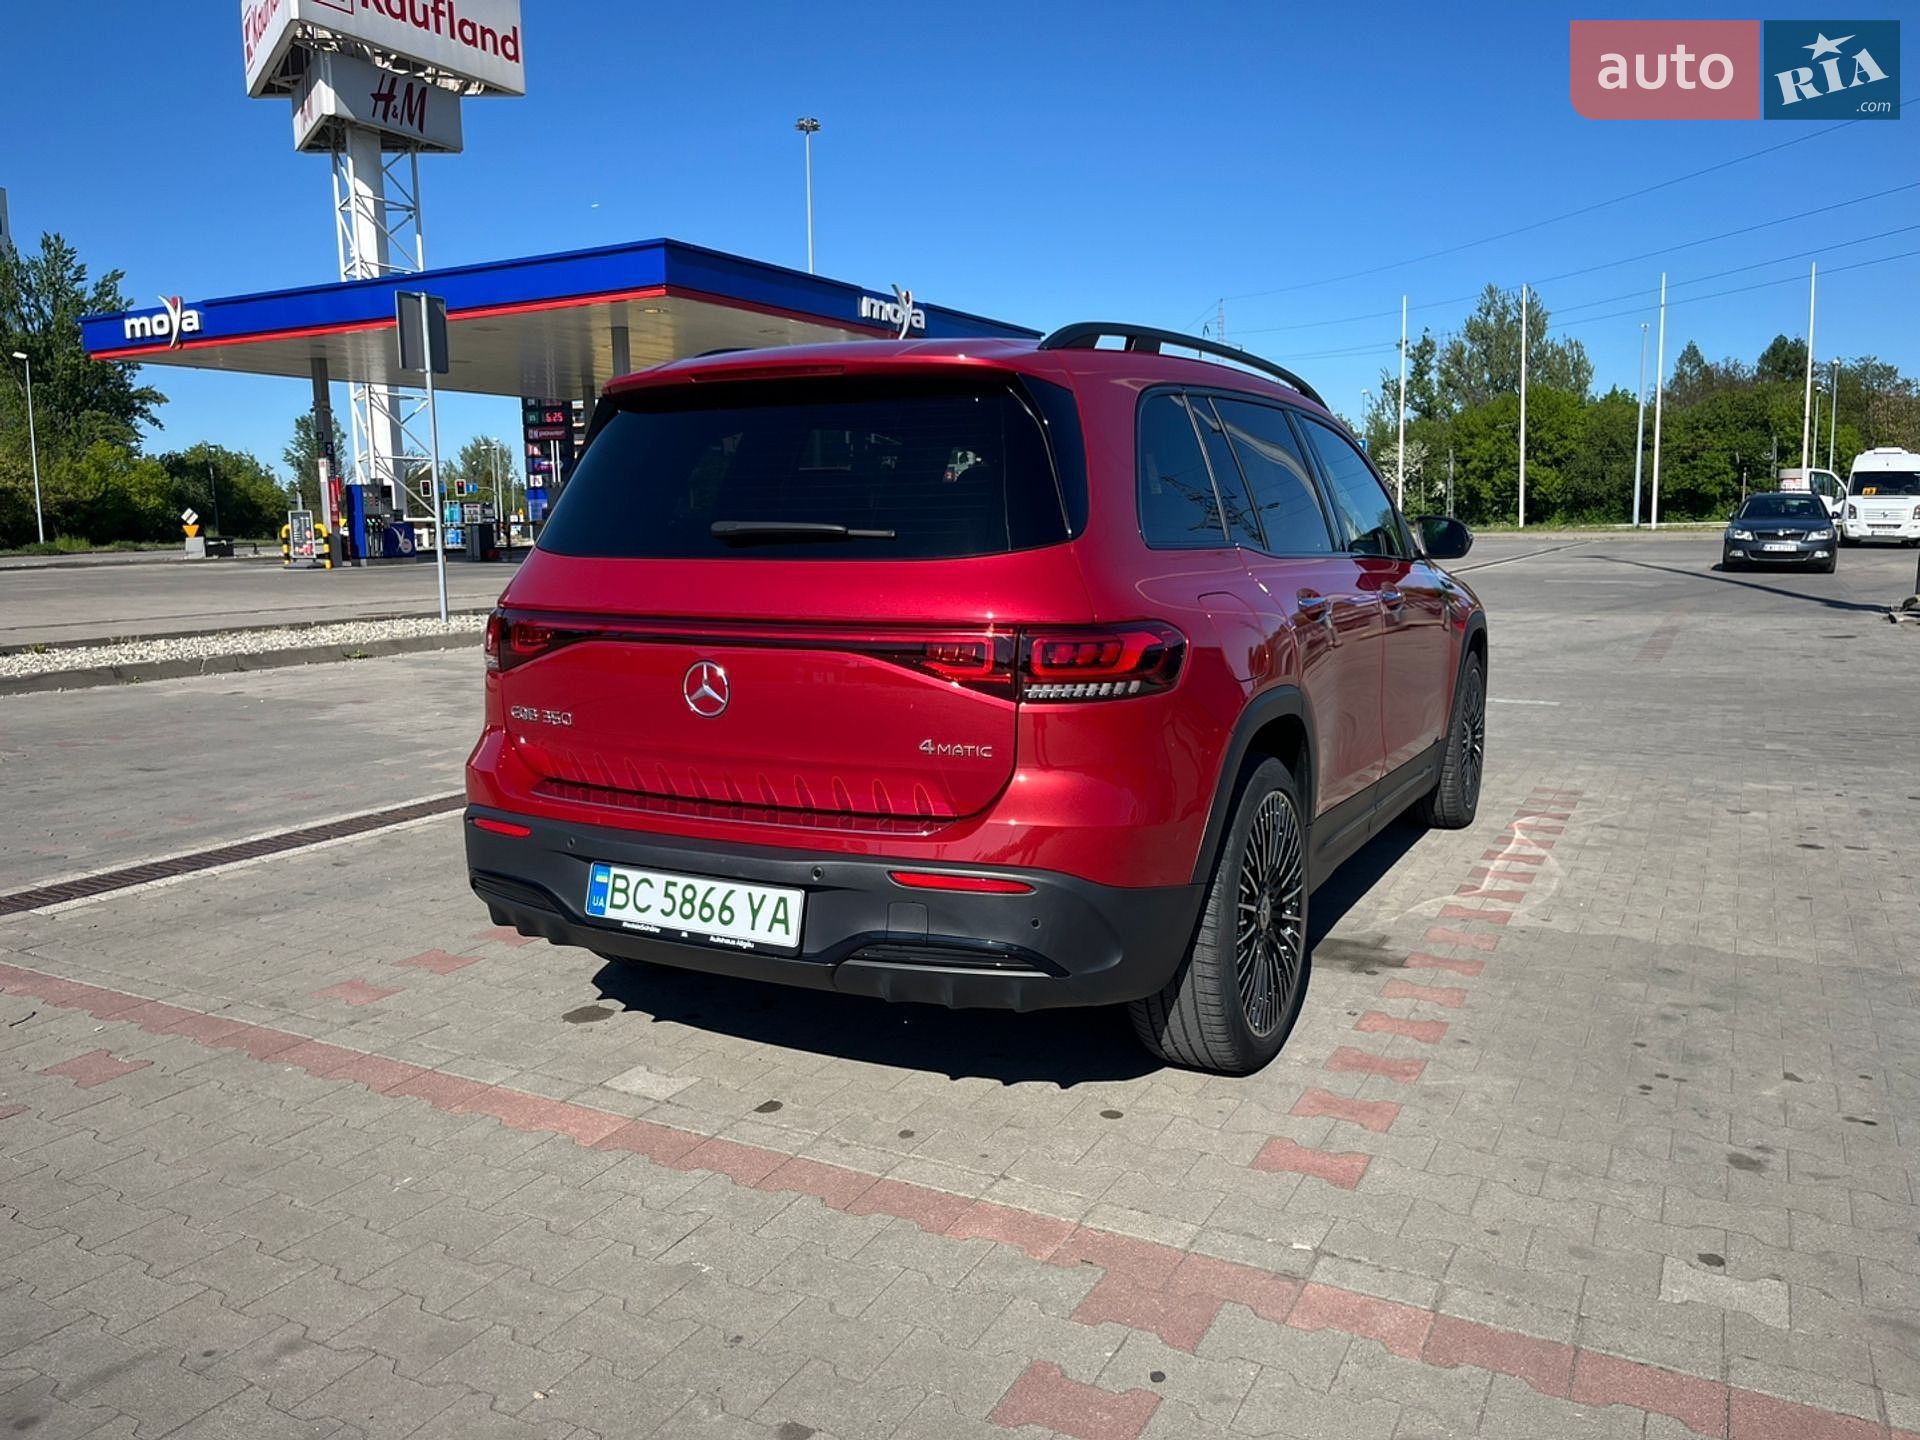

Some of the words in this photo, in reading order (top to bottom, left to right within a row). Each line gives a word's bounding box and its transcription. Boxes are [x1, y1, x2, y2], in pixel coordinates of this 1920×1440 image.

[370, 73, 427, 134] H&M
[124, 295, 200, 348] moya
[859, 284, 926, 340] moya
[542, 709, 572, 726] 350
[919, 738, 993, 758] 4MATIC
[592, 895, 606, 908] UA
[609, 873, 655, 914] BC
[660, 880, 737, 926] 5866
[747, 891, 791, 936] YA
